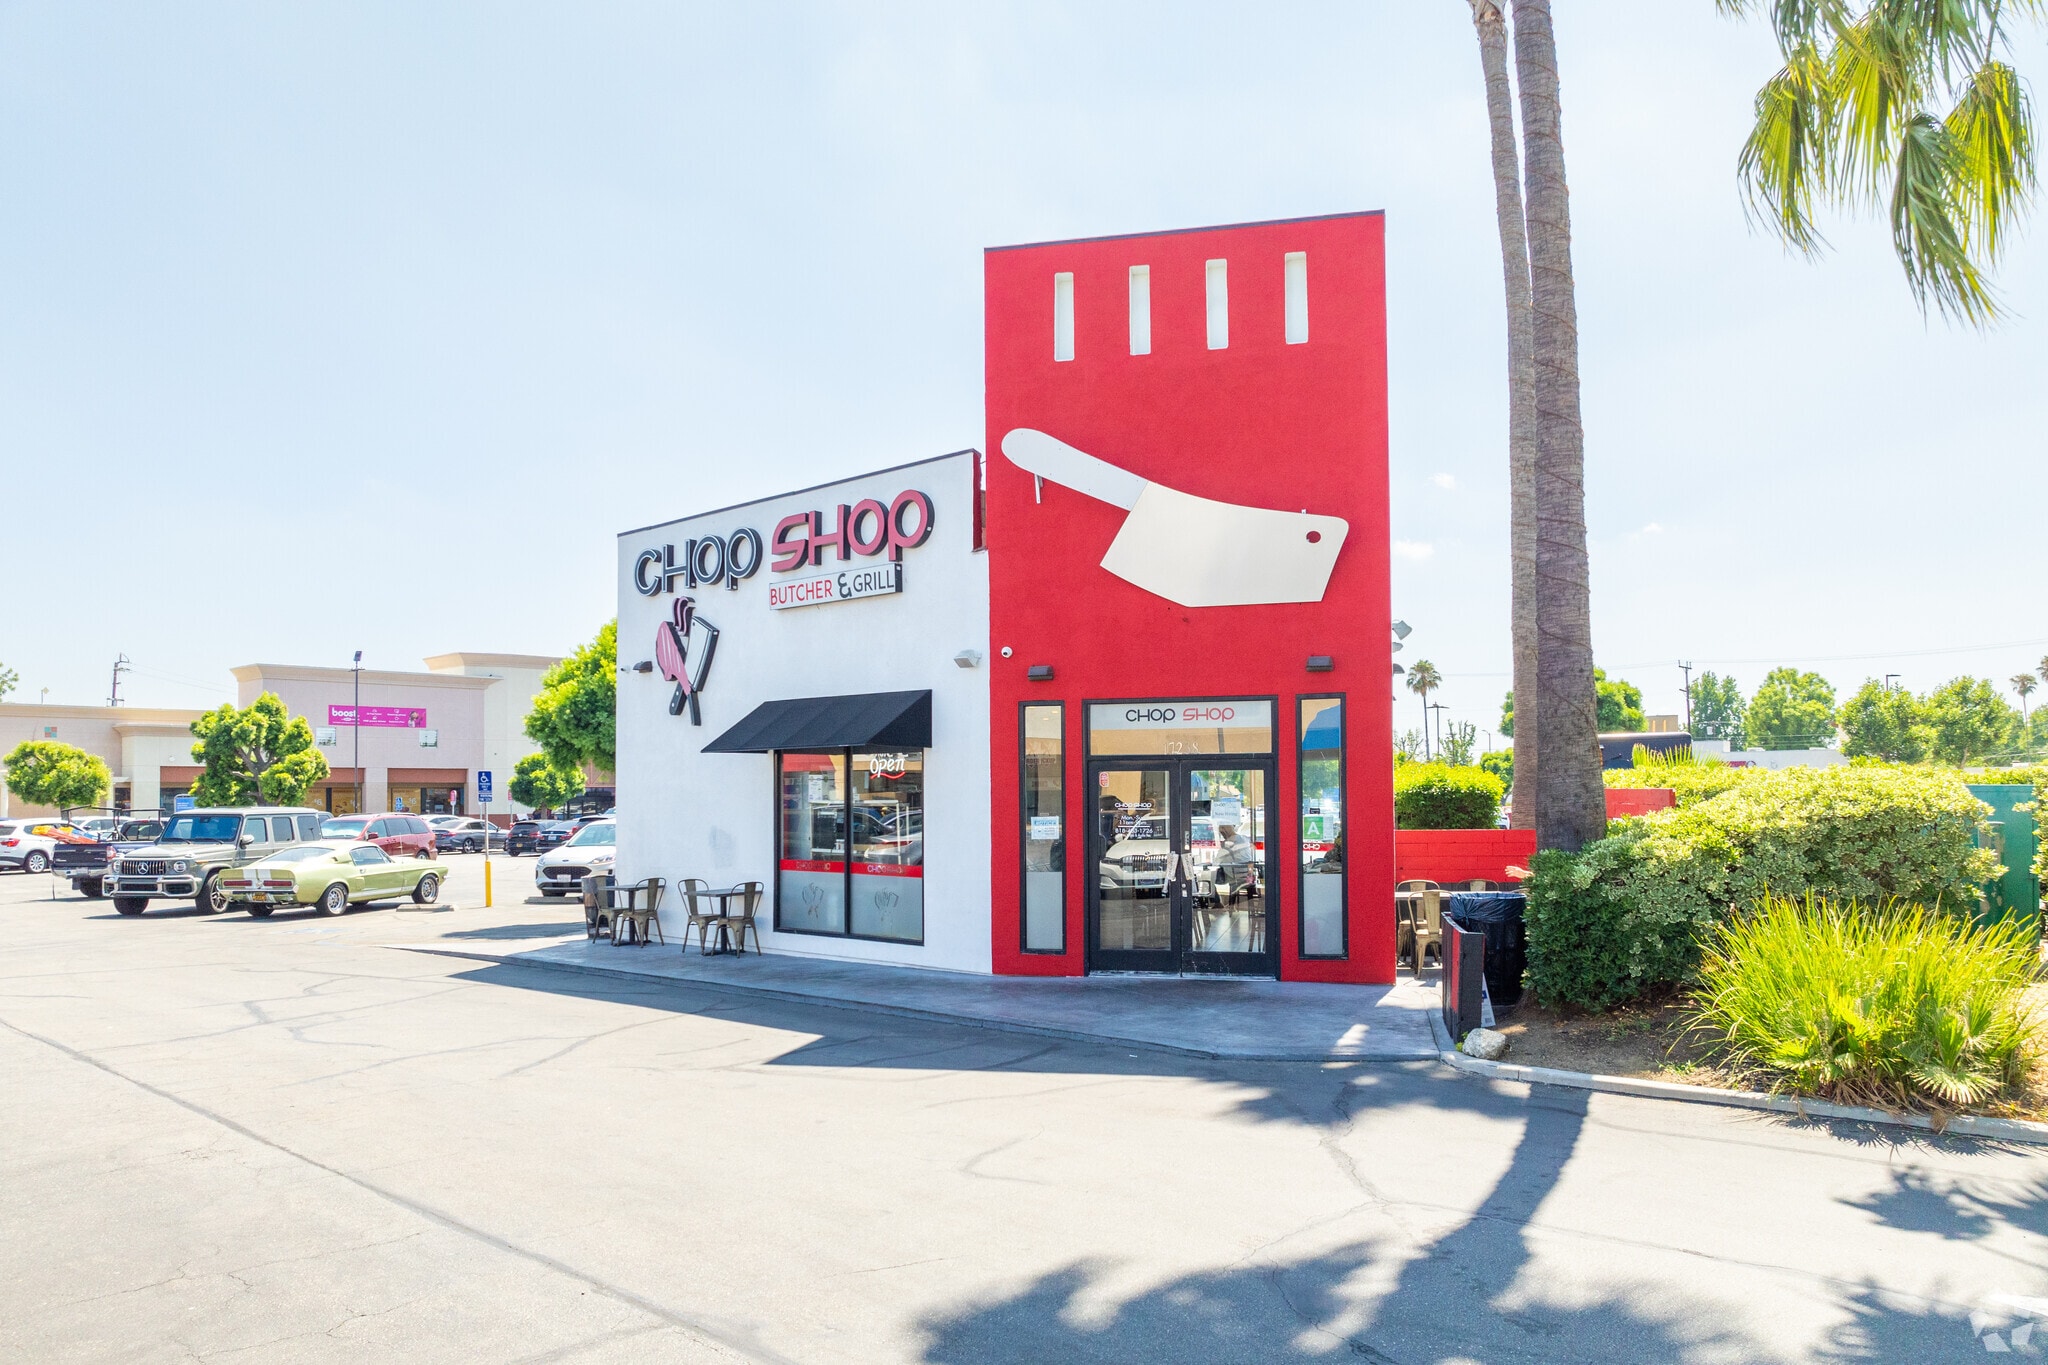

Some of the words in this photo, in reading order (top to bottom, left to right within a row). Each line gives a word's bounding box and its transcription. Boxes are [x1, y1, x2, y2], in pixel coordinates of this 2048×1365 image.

[771, 489, 935, 573] SHOP
[770, 579, 833, 606] BUTCHER
[837, 572, 852, 599] &
[853, 570, 894, 593] GRILL
[1126, 708, 1176, 723] CHOP
[1182, 707, 1235, 722] SHOP
[870, 758, 905, 778] Open
[1307, 821, 1320, 835] A
